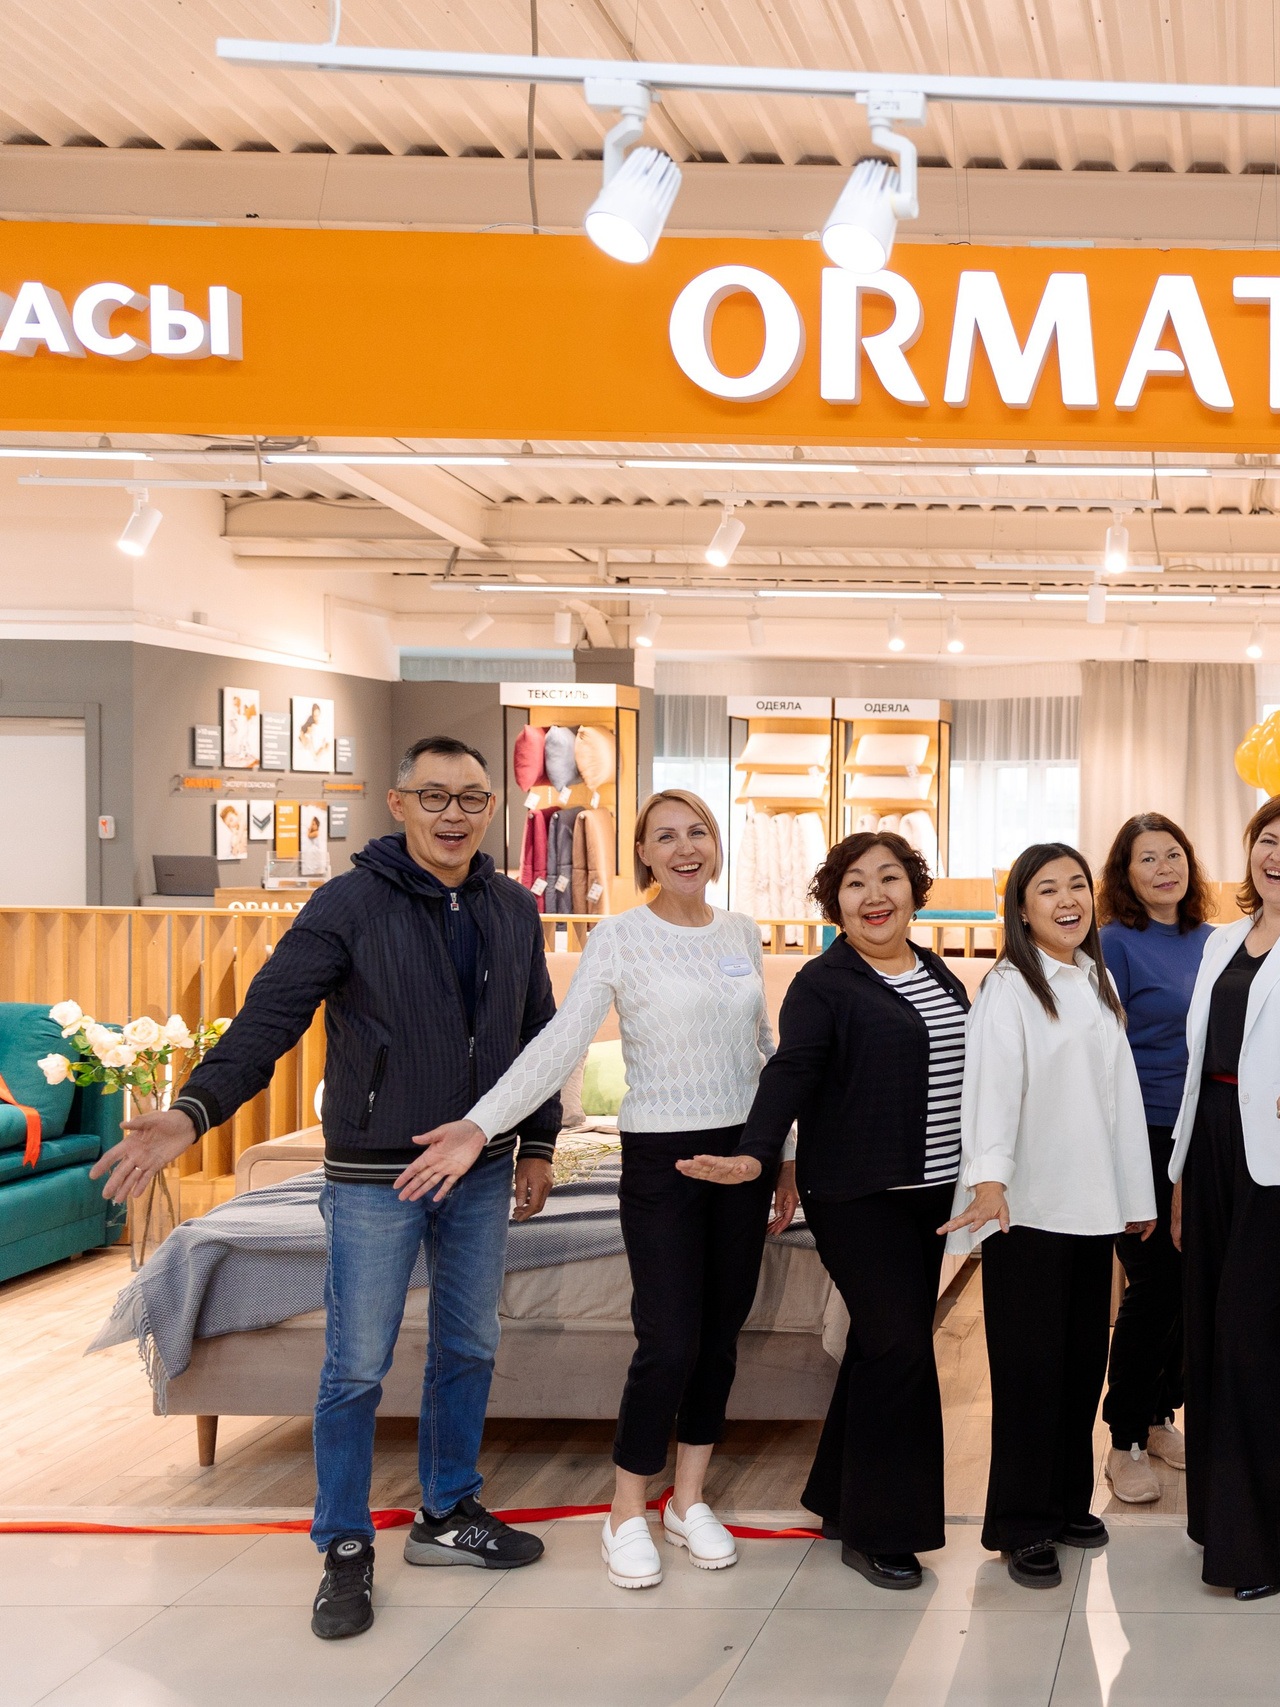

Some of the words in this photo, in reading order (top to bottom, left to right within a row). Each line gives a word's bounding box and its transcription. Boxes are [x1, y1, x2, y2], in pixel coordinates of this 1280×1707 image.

[0, 281, 241, 360] АСЫ
[527, 689, 589, 700] ТЕКСТИЛЬ
[756, 700, 802, 711] ОДЕЯЛА
[864, 703, 910, 713] ОДЕЯЛА
